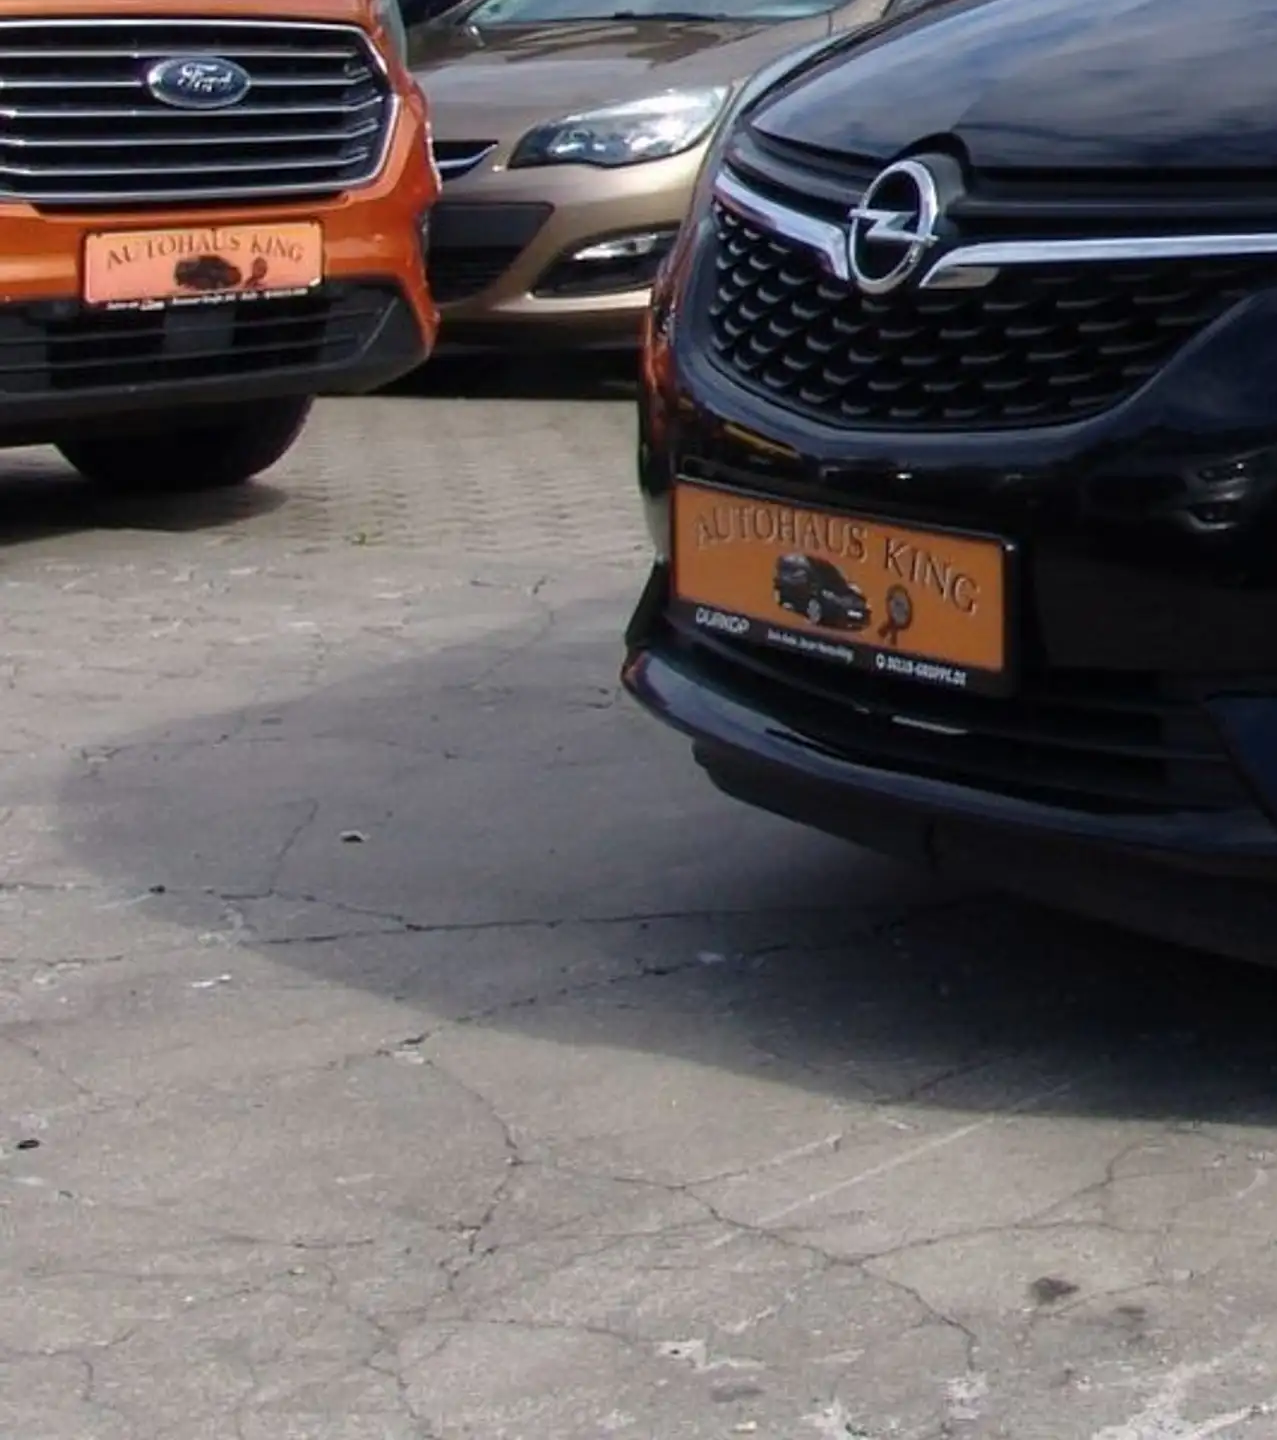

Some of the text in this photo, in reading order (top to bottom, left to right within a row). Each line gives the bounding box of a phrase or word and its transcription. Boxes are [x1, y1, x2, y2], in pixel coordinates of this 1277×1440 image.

[178, 62, 233, 93] Ford
[106, 231, 305, 270] AUTOHAUS KING
[695, 506, 981, 617] AUTOHAUS KING
